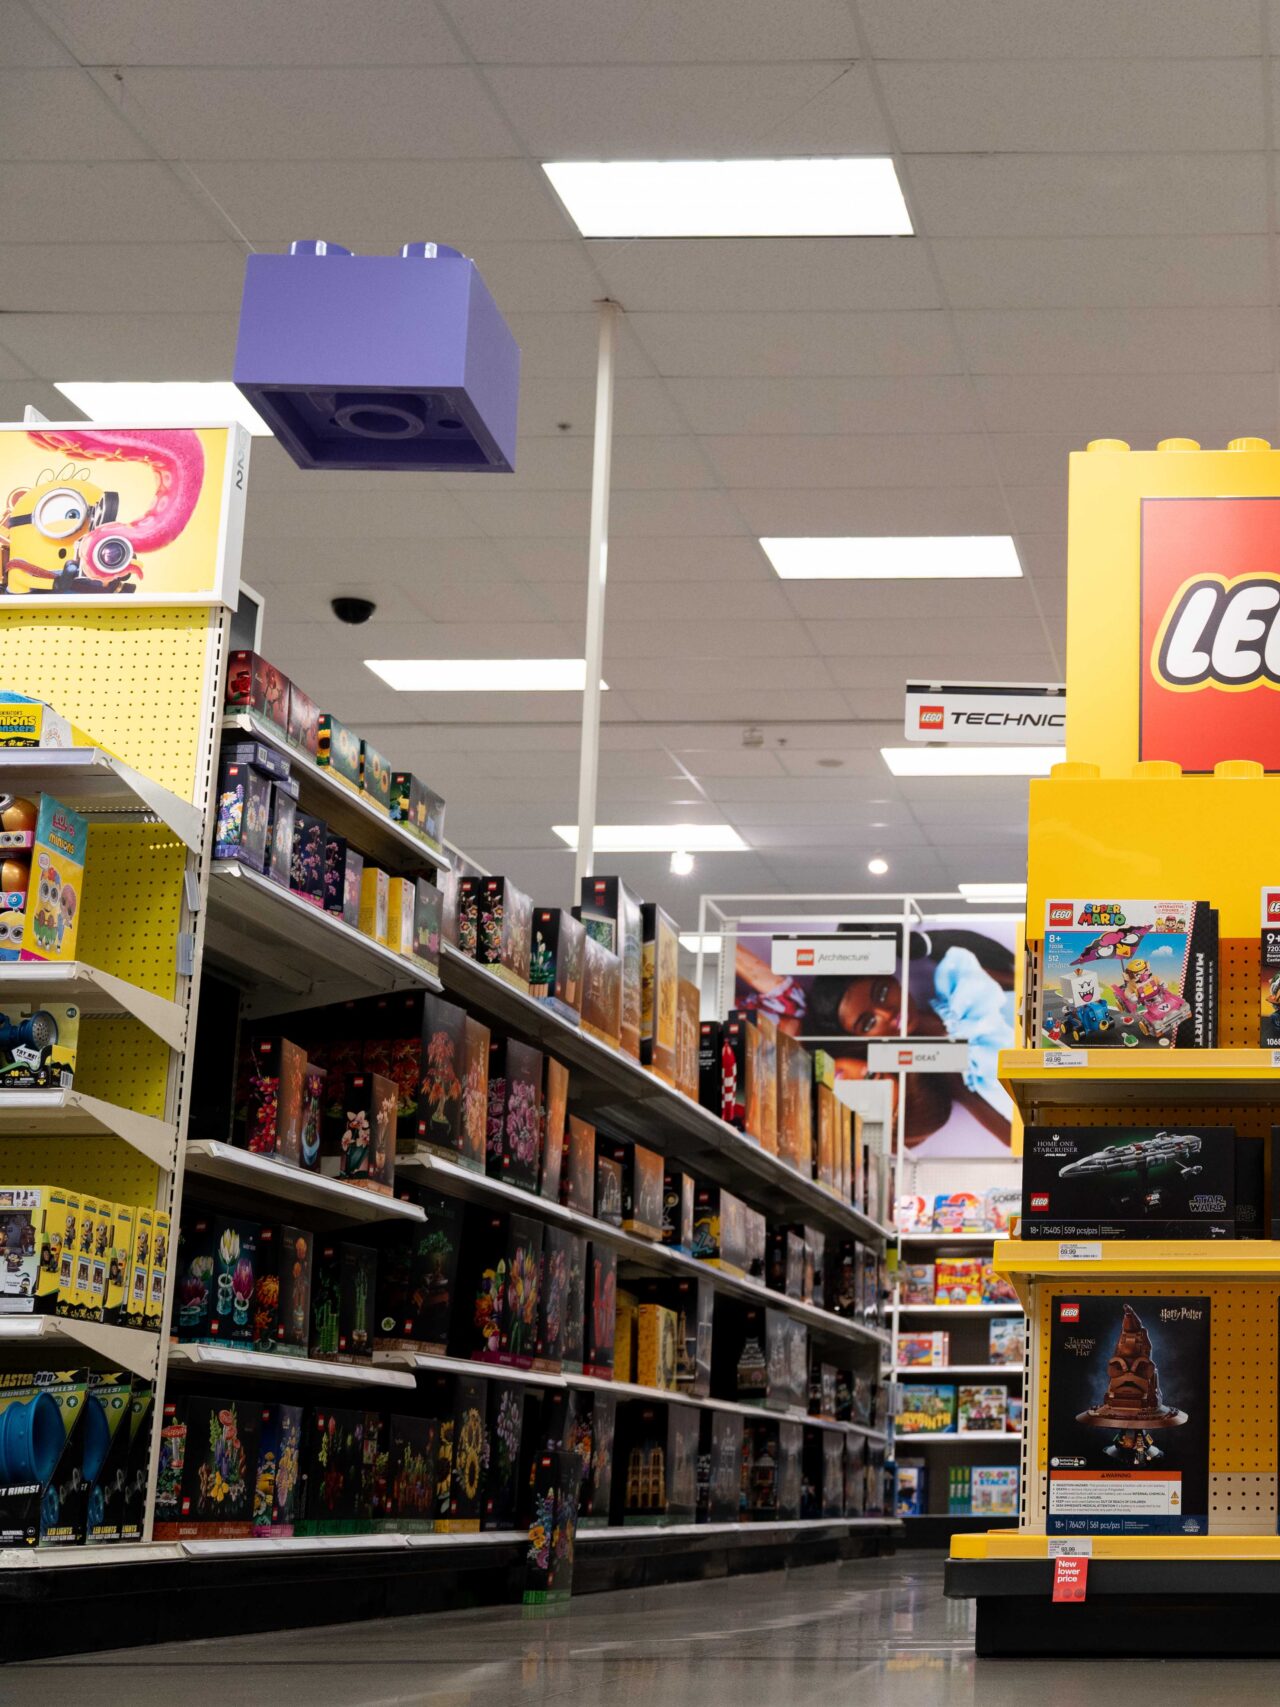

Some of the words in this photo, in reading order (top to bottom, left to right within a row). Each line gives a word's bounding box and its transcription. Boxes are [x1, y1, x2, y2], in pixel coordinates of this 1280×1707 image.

[0, 716, 36, 726] nions
[920, 712, 942, 722] LEGO
[951, 712, 1066, 726] TECHNIC
[1084, 903, 1122, 914] SUPER
[1050, 908, 1072, 920] LEGO
[1078, 912, 1126, 926] MARIO
[1049, 935, 1062, 943] 8+
[818, 953, 870, 963] Architecture
[16, 1048, 26, 1057] TRY
[1030, 1198, 1049, 1206] LEGO
[1193, 1194, 1224, 1204] STAR
[1189, 1202, 1226, 1212] WARS
[1030, 1226, 1040, 1234] 18+
[1042, 1226, 1061, 1234] 75405
[1064, 1226, 1076, 1234] 559
[1076, 1226, 1098, 1236] pcs/pzs
[1060, 1308, 1080, 1318] LEGO
[1160, 1308, 1181, 1322] Harry
[1182, 1307, 1202, 1320] Potter
[0, 1373, 34, 1387] LASTER
[8, 1484, 40, 1496] RINGS!
[1068, 1520, 1086, 1528] 76429
[1090, 1520, 1099, 1528] 561
[1100, 1521, 1120, 1530] pcs/pzs
[1058, 1560, 1077, 1568] New
[1057, 1575, 1078, 1584] price
